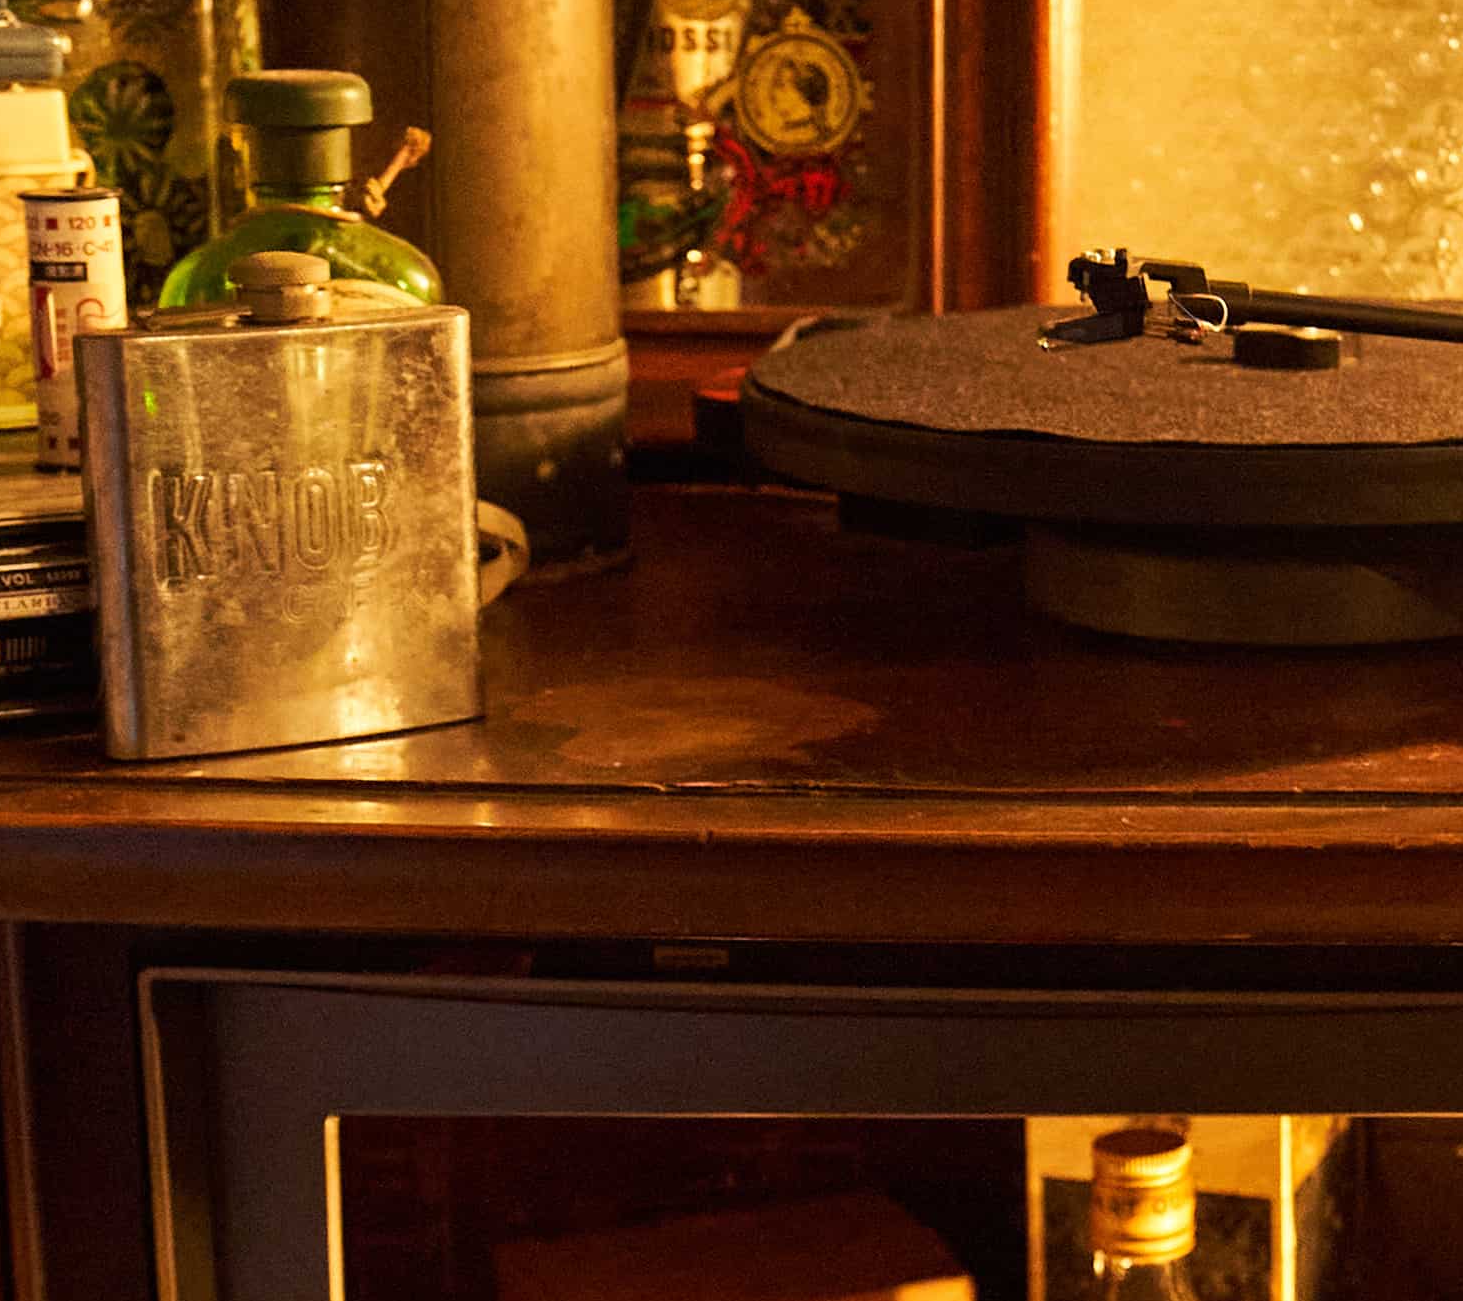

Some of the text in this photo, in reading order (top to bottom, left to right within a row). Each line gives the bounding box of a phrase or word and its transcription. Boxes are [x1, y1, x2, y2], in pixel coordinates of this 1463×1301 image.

[68, 216, 96, 231] 120
[148, 462, 394, 593] KNOB
[0, 572, 35, 587] VOL
